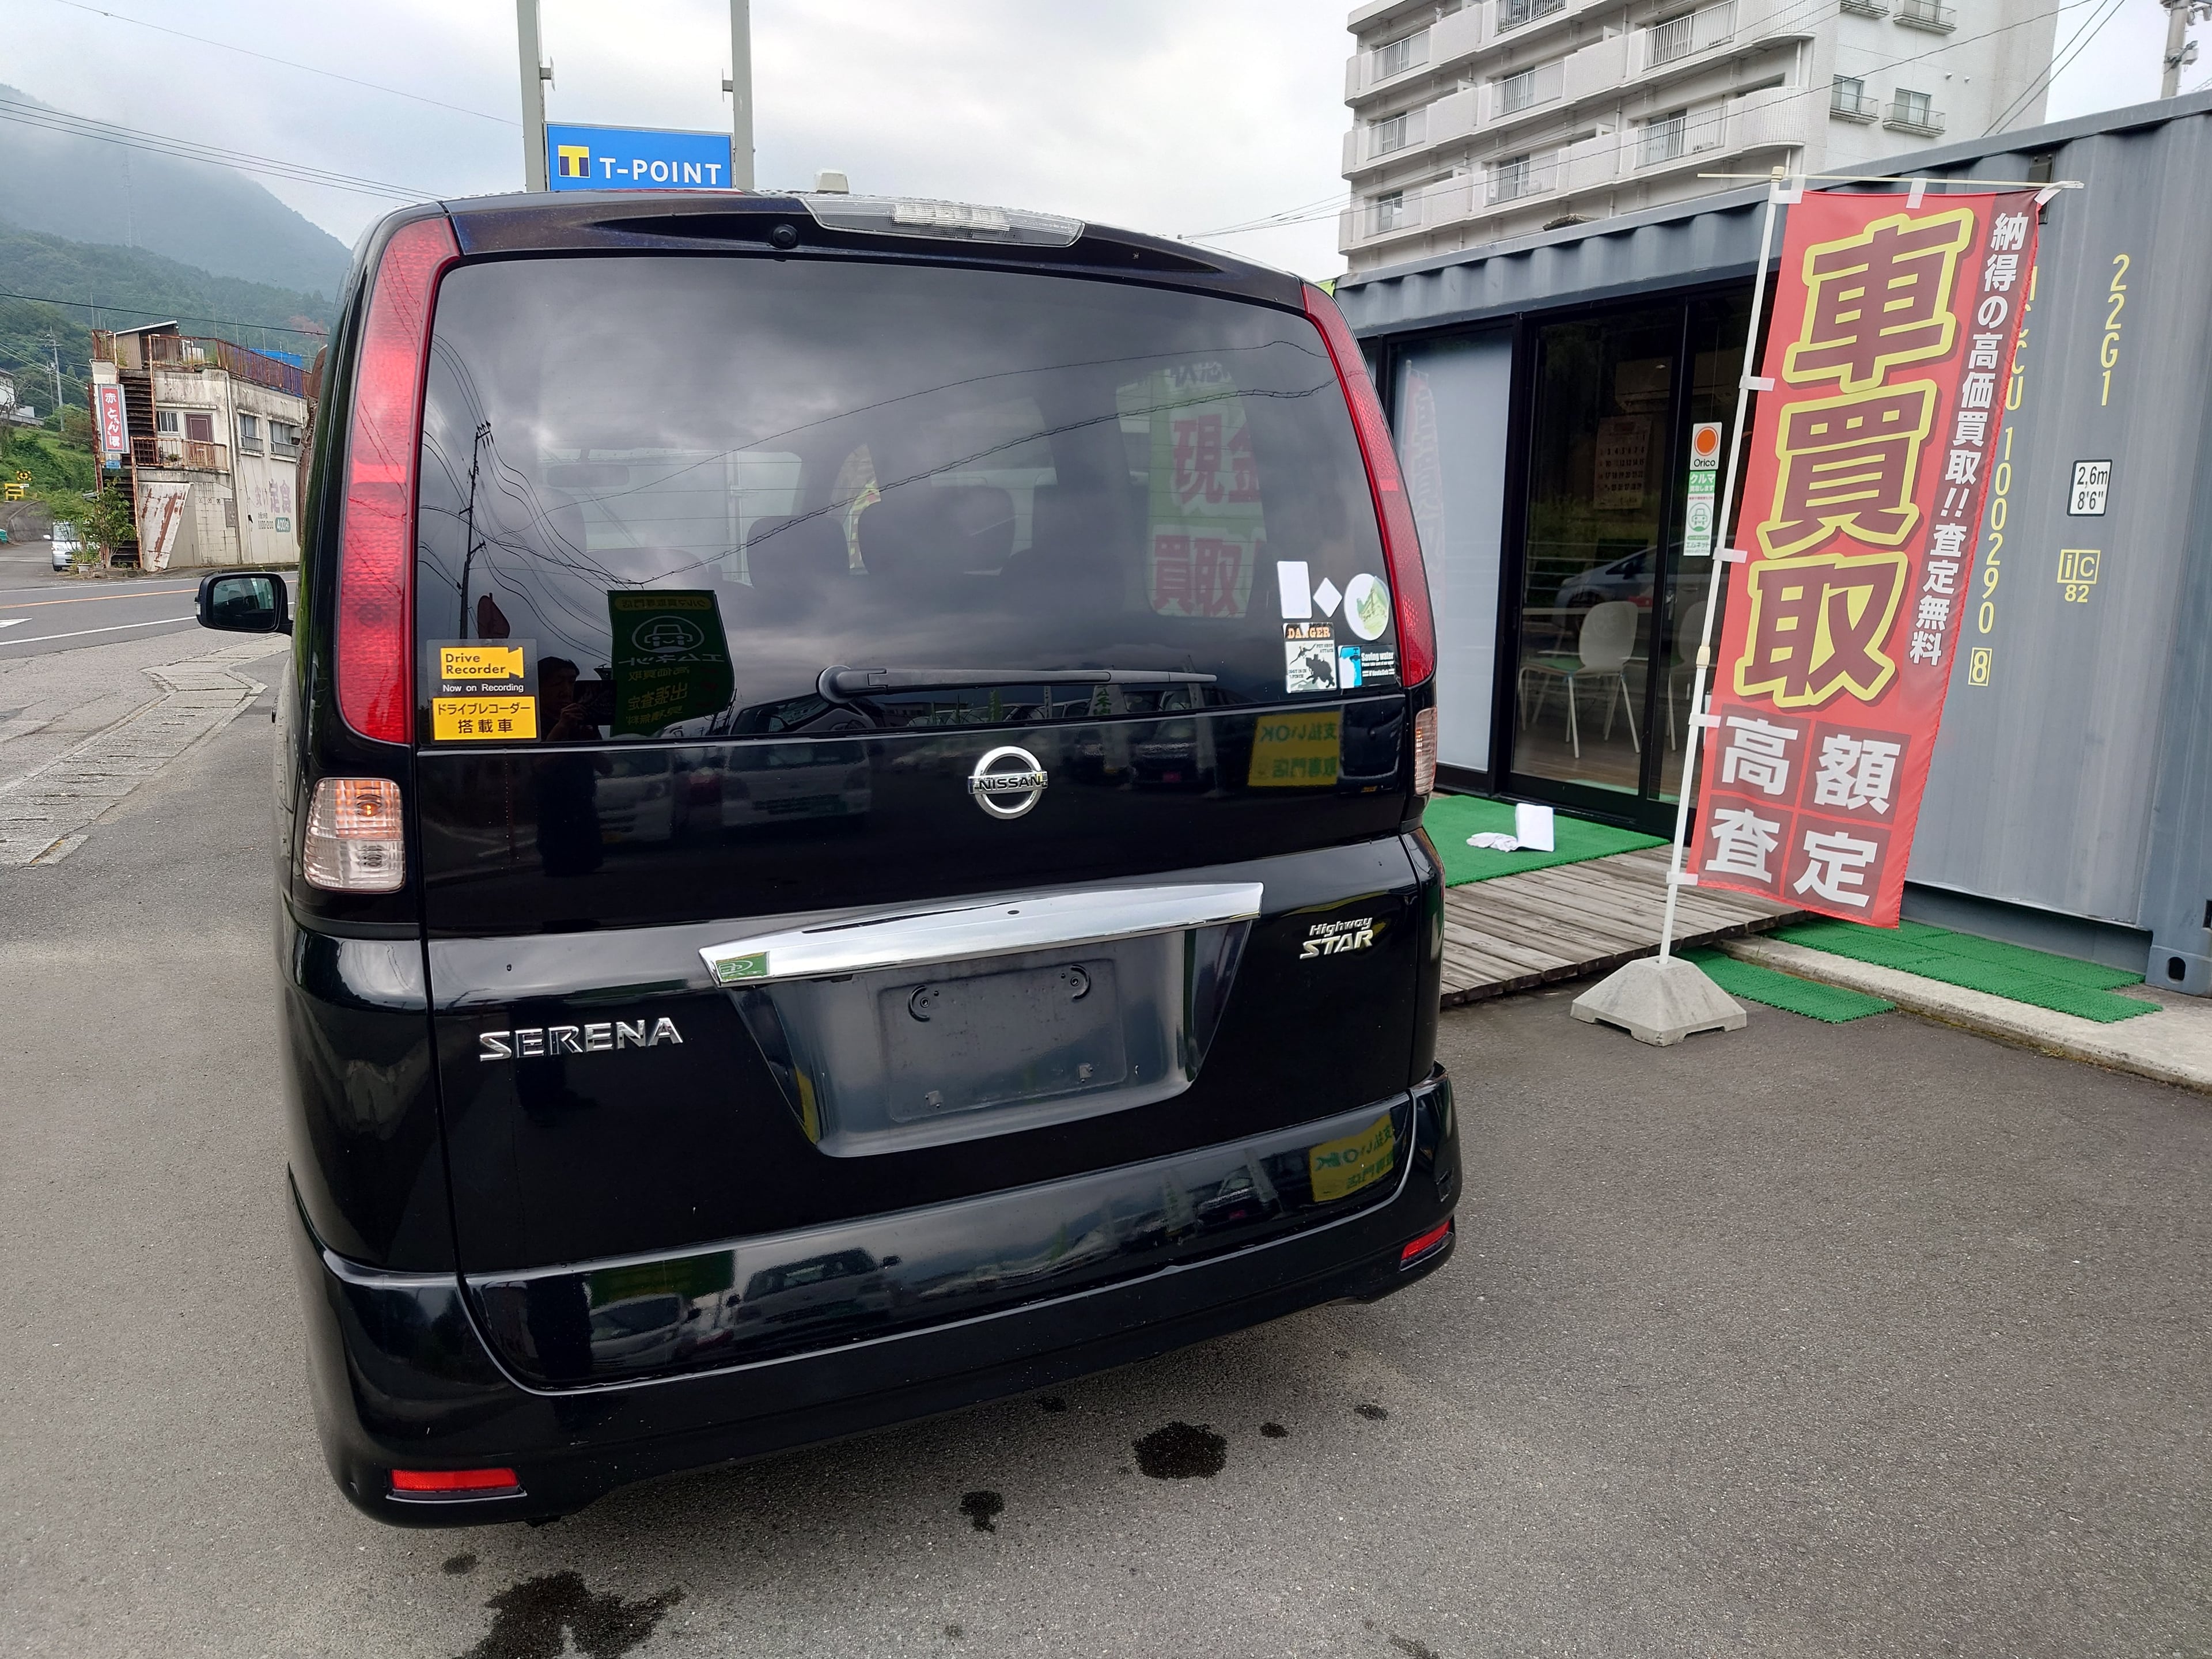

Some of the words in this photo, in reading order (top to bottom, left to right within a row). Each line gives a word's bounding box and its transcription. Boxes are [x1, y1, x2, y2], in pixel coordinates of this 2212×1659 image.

[599, 157, 722, 184] T-POINT
[2101, 254, 2130, 406] 22G1
[1694, 459, 1715, 467] Orico
[1733, 208, 1975, 707] 車買取
[1690, 473, 1715, 484] クルマ
[1978, 427, 2013, 634] 100290
[1153, 535, 1243, 618] 買取
[2065, 584, 2089, 603] 82
[445, 653, 480, 662] Drive
[1361, 652, 1379, 661] Saving
[1380, 652, 1393, 660] water
[446, 664, 506, 674] Recorder
[482, 684, 524, 693] Recording
[438, 702, 531, 715] ドライブレコーダー
[458, 719, 513, 733] 搭載車
[1722, 715, 1901, 815] 高額
[979, 776, 1040, 790] NISSAN
[1705, 808, 1878, 908] 査定
[1309, 918, 1373, 937] Highway
[1300, 929, 1373, 960] STAR
[479, 1017, 683, 1062] SERENA
